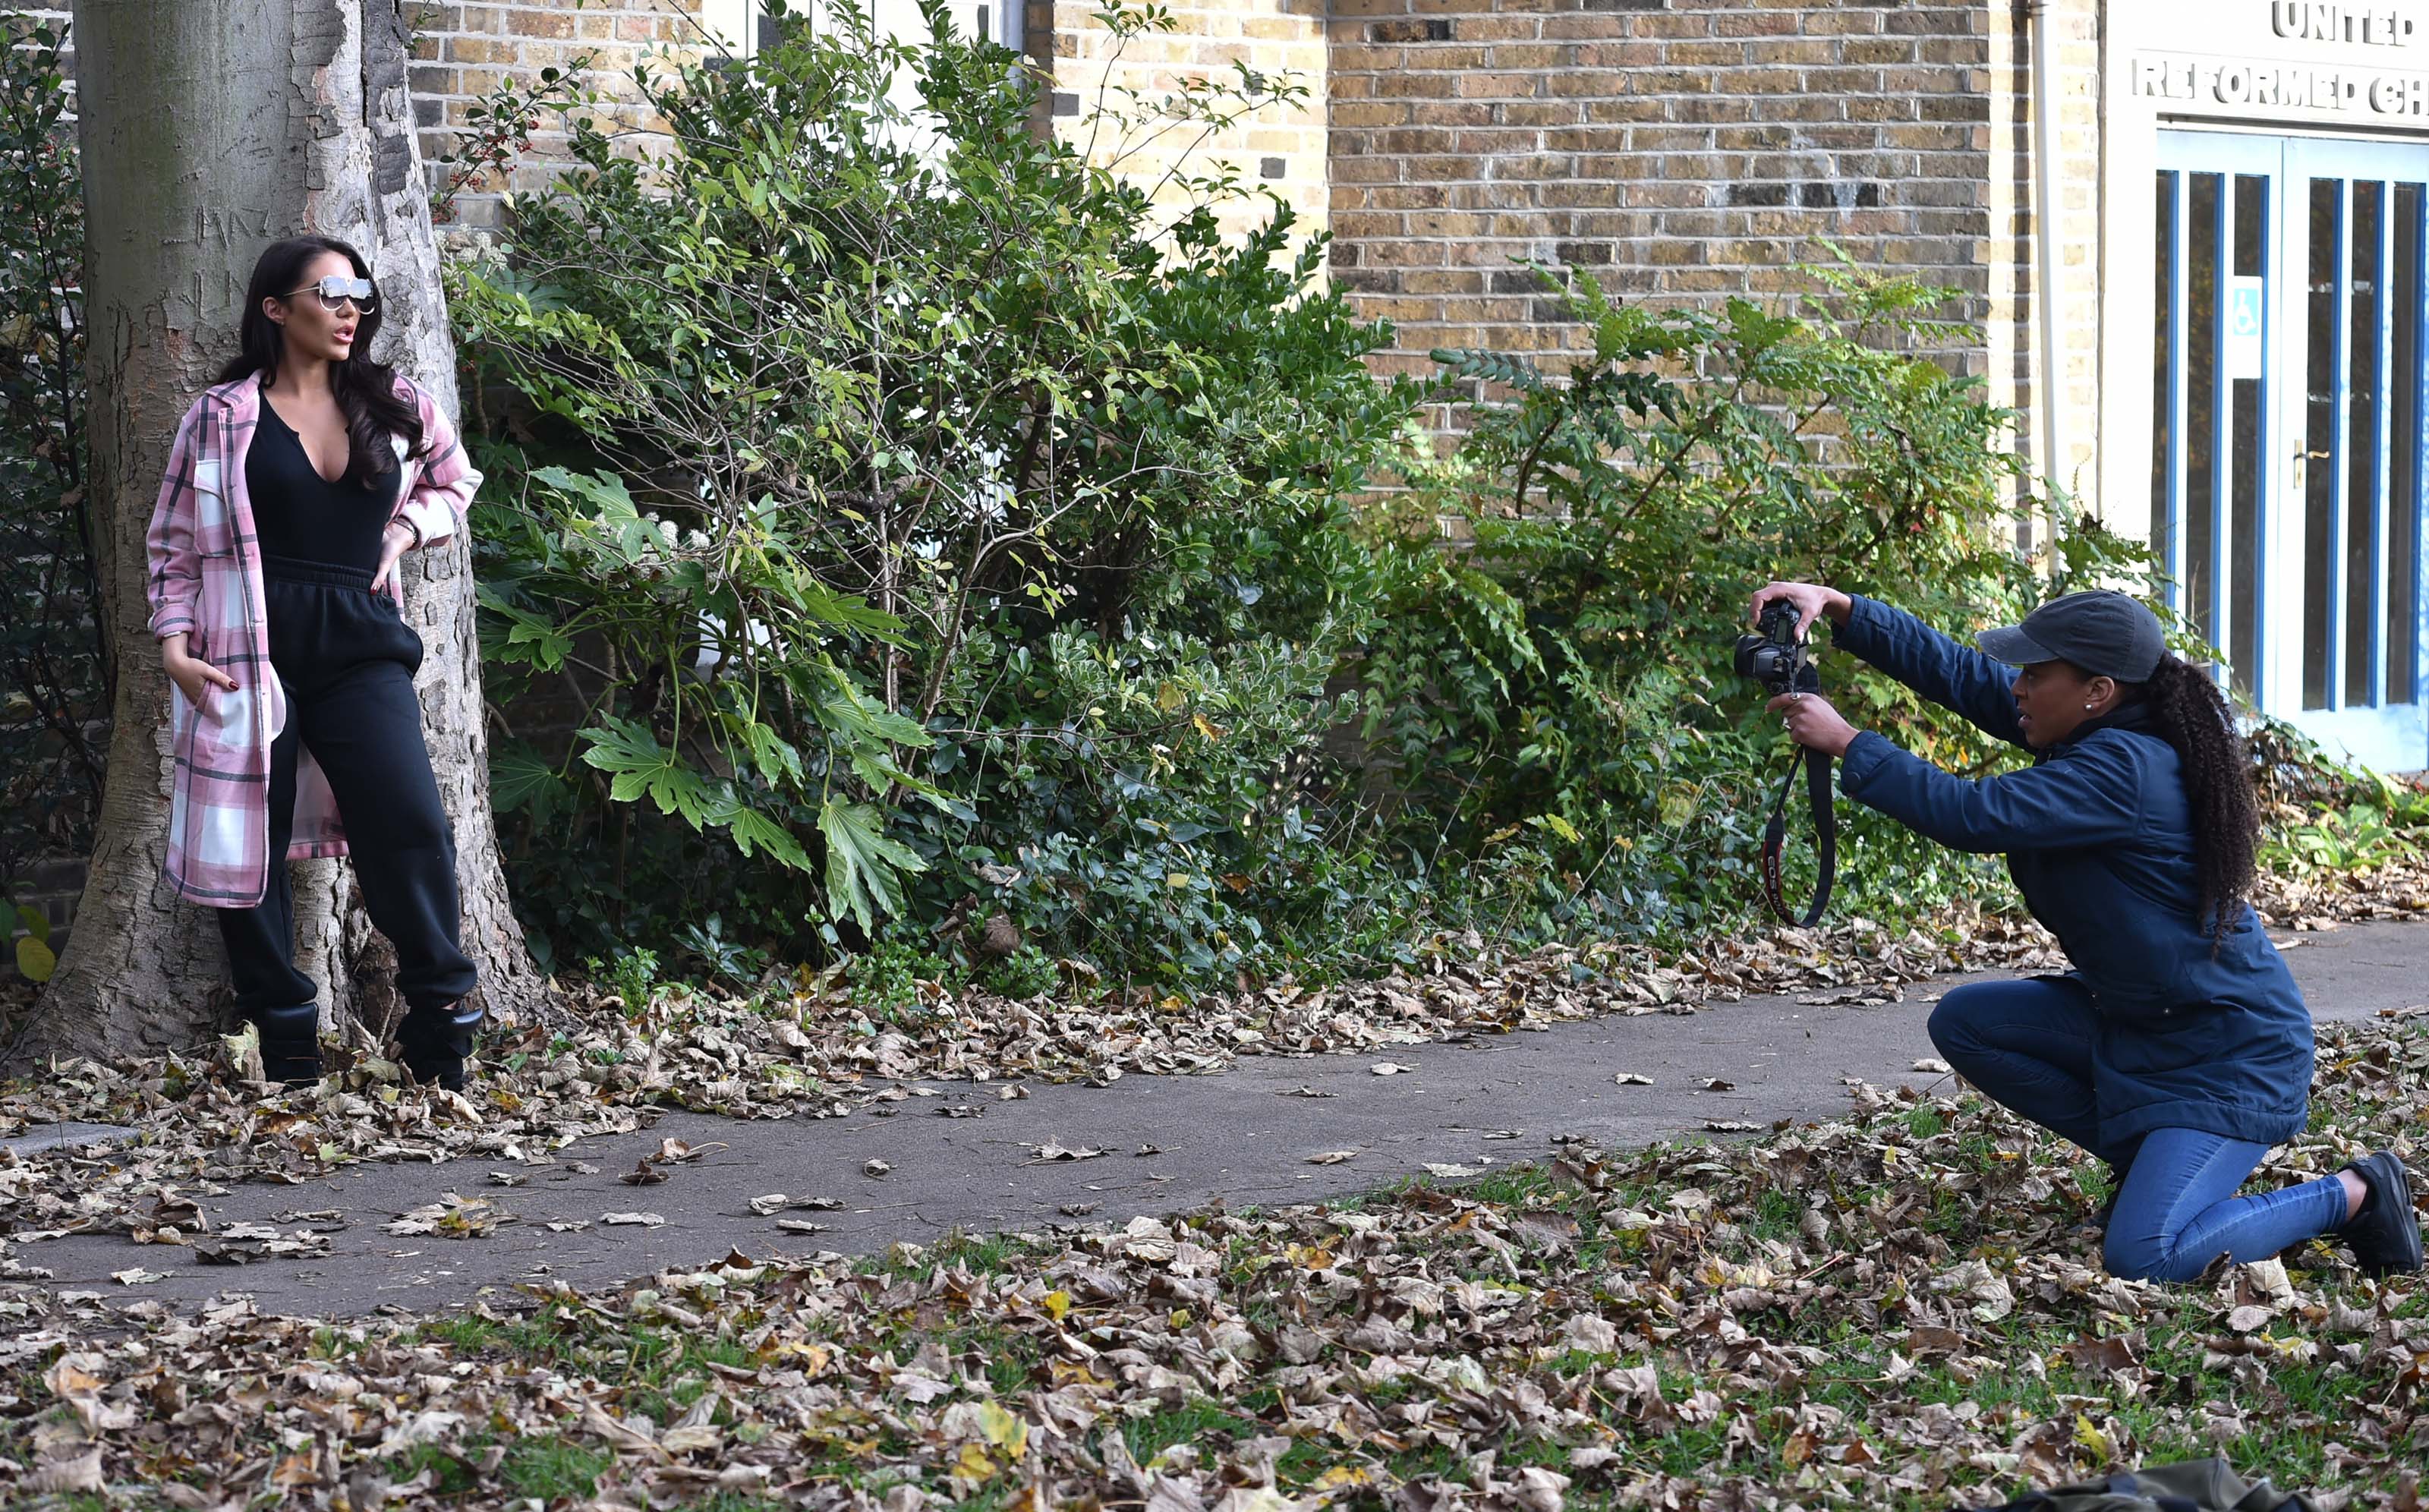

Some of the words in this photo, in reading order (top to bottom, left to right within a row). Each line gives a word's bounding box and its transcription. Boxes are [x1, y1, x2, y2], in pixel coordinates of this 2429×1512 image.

[2271, 0, 2417, 47] UNITED
[2131, 58, 2361, 111] REFORMED
[1768, 855, 1777, 890] EOS
